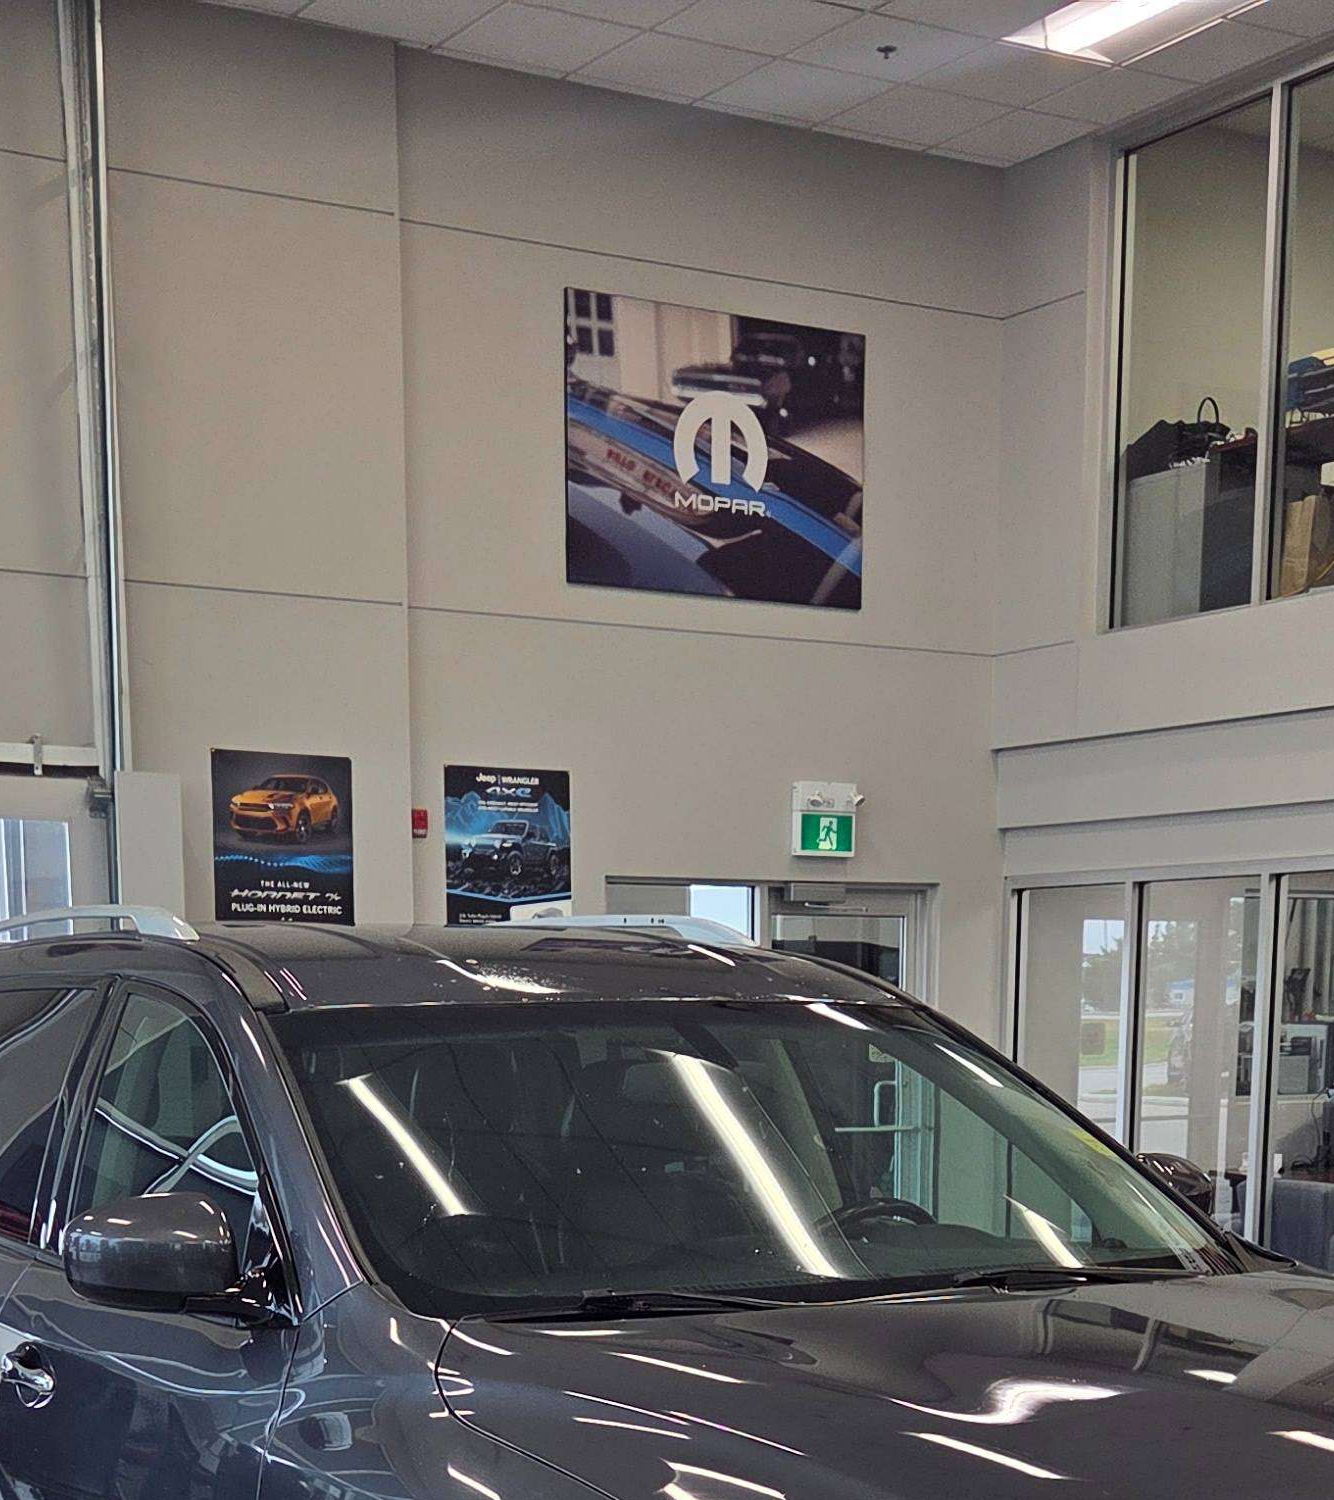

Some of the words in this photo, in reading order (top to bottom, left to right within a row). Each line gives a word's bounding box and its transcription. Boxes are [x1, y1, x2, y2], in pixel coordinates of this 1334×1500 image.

[674, 490, 766, 518] MOPAR
[260, 879, 275, 888] THE
[277, 880, 310, 889] ALL-NEW
[231, 902, 267, 913] PLUG-IN
[269, 903, 301, 914] HYBRID
[302, 904, 343, 915] ELECTRIC
